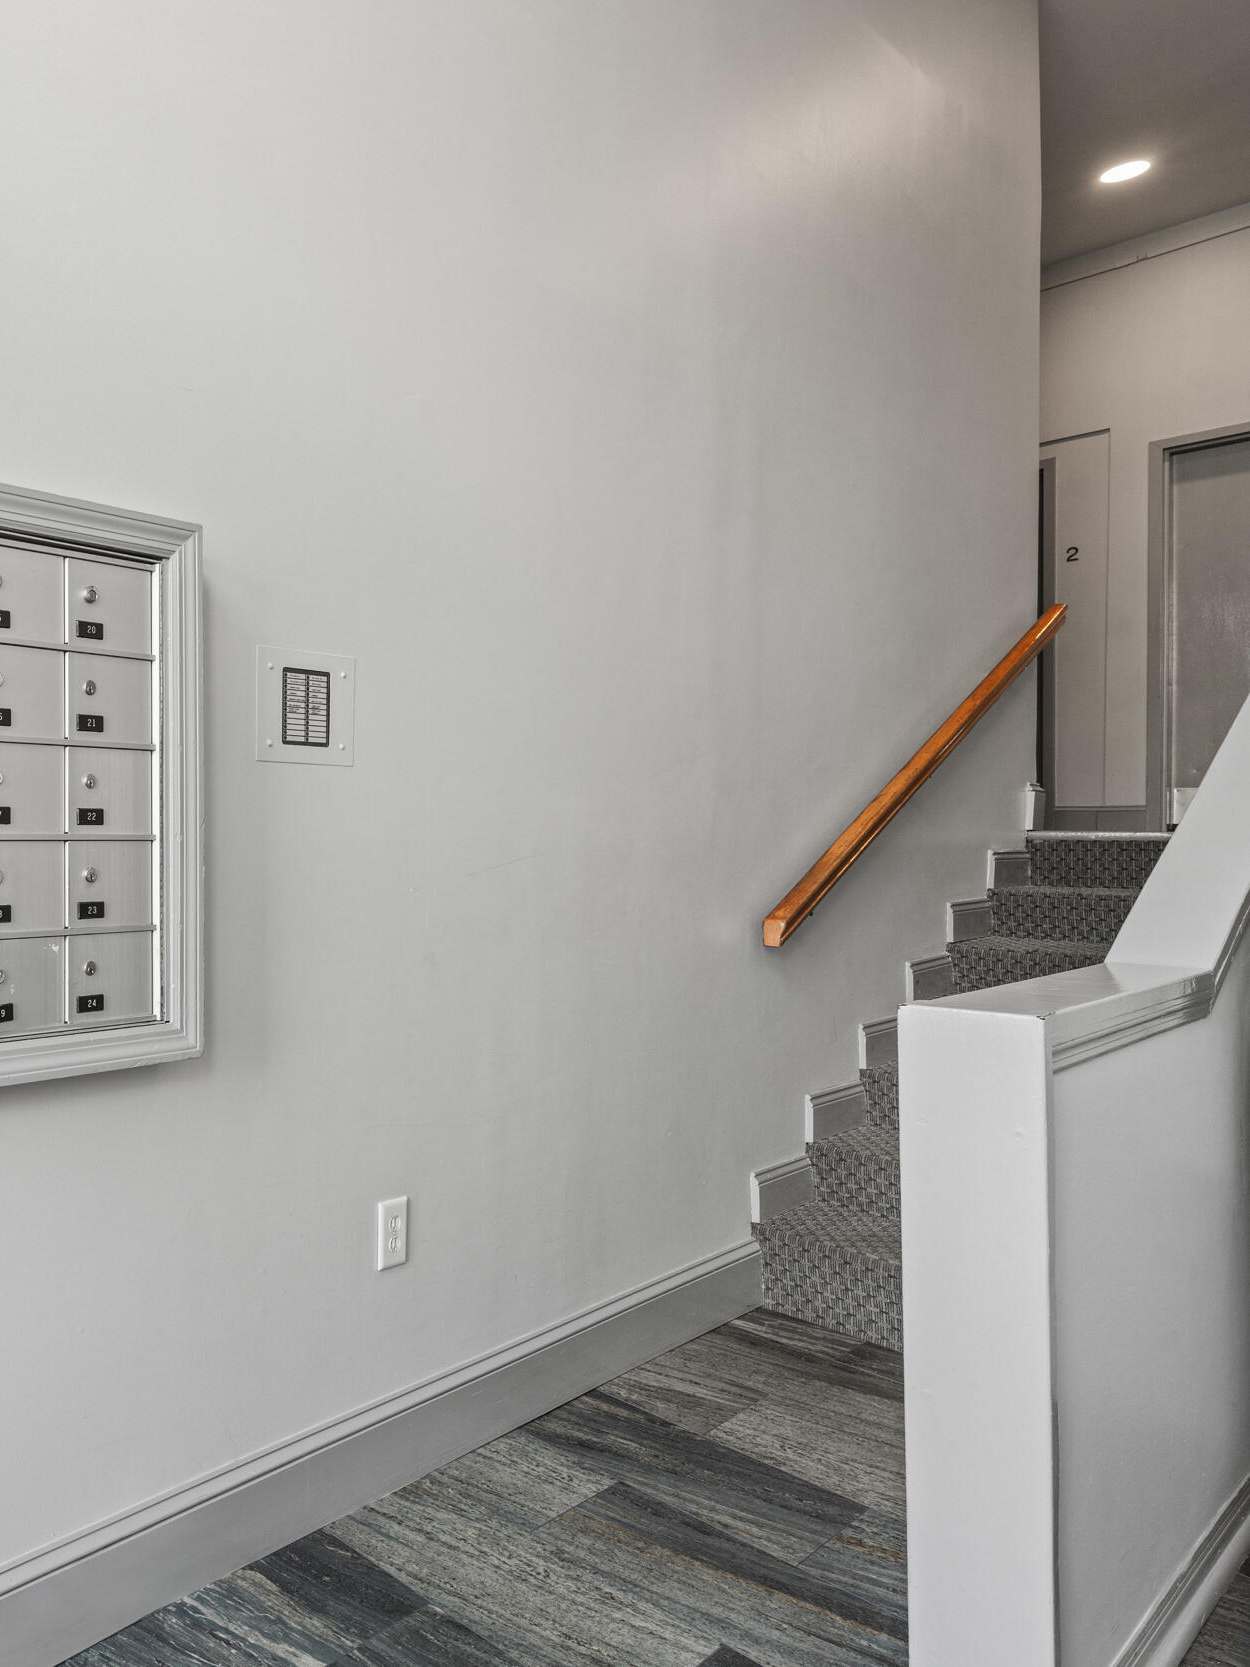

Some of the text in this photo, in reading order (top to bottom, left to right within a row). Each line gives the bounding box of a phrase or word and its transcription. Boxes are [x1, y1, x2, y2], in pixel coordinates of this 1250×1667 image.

[1066, 546, 1079, 562] 2
[87, 625, 96, 634] 20
[87, 718, 96, 727] 21
[87, 812, 97, 821] 22
[87, 906, 97, 915] 23
[87, 999, 97, 1008] 24
